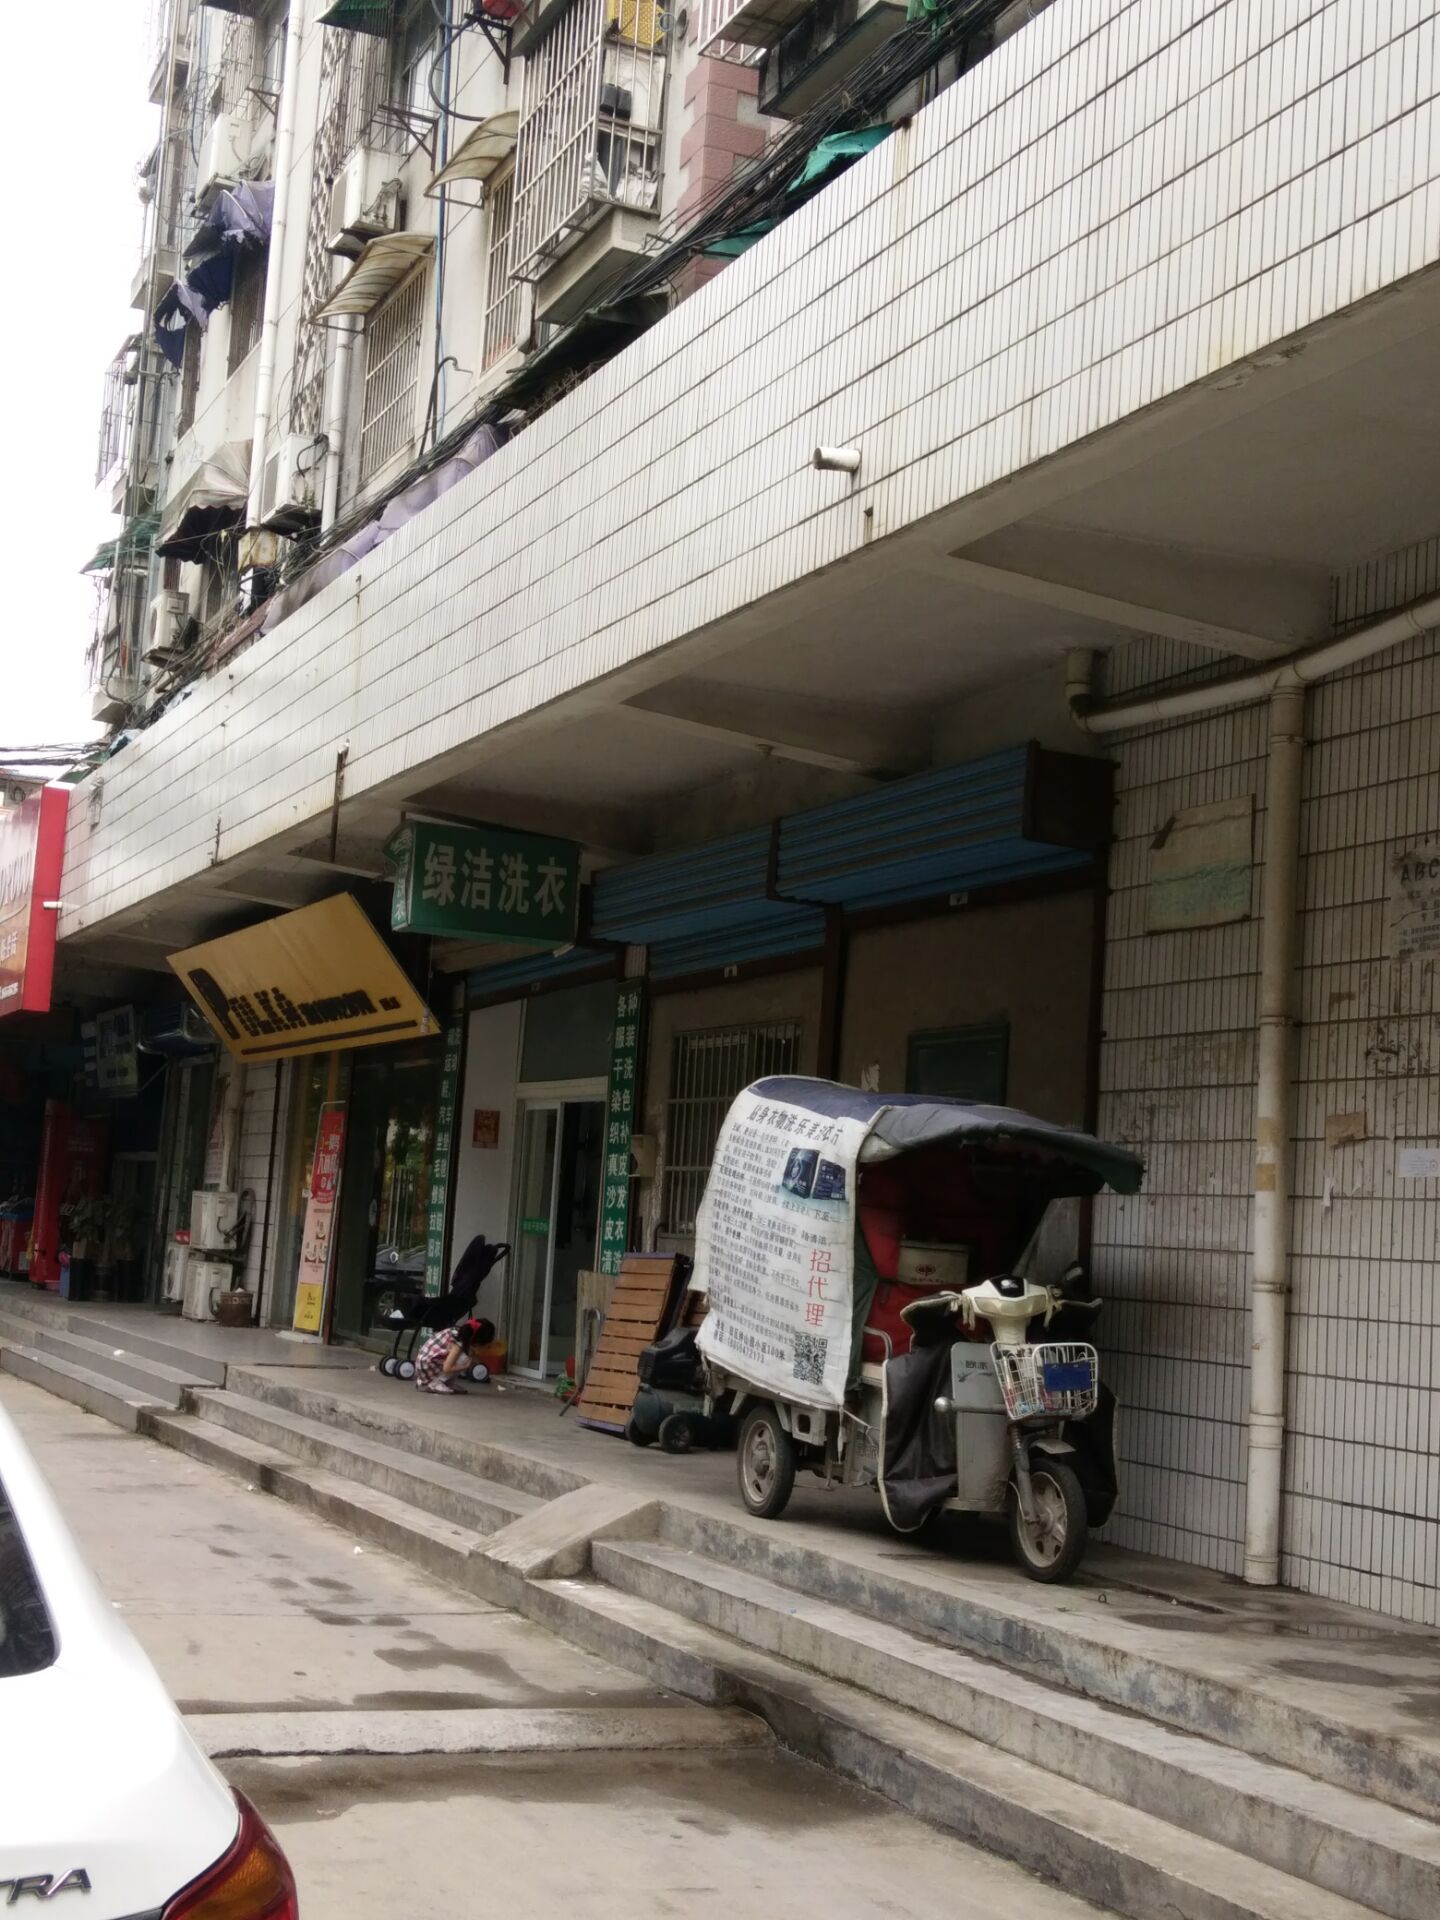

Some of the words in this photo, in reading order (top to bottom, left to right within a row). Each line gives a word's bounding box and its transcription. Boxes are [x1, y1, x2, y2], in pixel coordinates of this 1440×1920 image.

[422, 842, 568, 917] 绿洁洗衣
[617, 992, 638, 1018] 各种
[615, 1025, 636, 1049] 服装
[613, 1057, 633, 1081] 干洗
[611, 1089, 632, 1113] 染色
[609, 1121, 629, 1145] 织补
[607, 1153, 627, 1177] 真皮
[606, 1185, 627, 1209] 沙发
[604, 1217, 624, 1241] 皮衣
[805, 1248, 832, 1327] 招代理
